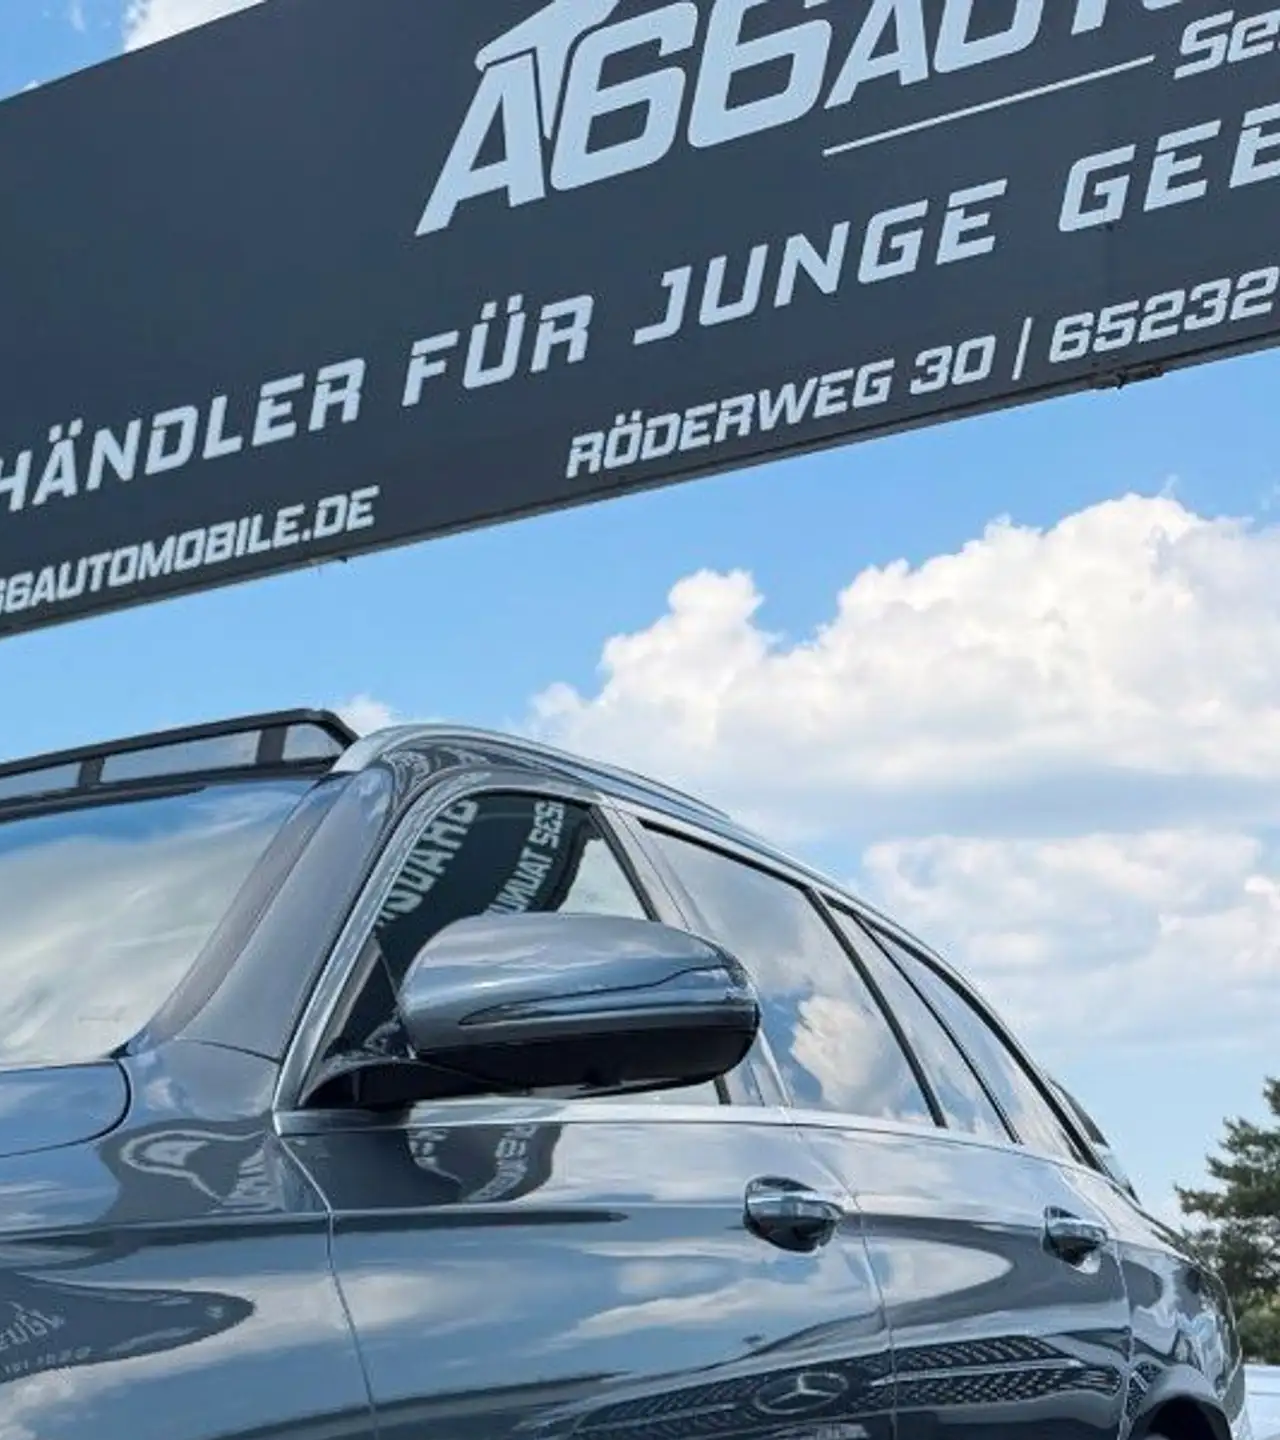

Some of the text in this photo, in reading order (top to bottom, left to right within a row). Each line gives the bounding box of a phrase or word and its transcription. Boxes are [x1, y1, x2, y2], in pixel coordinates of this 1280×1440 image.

[402, 293, 595, 406] FÜR
[632, 178, 1008, 345] JUNGE
[565, 357, 895, 478] RÖDERWEG
[909, 334, 996, 396] 30
[1048, 264, 1280, 364] 65232
